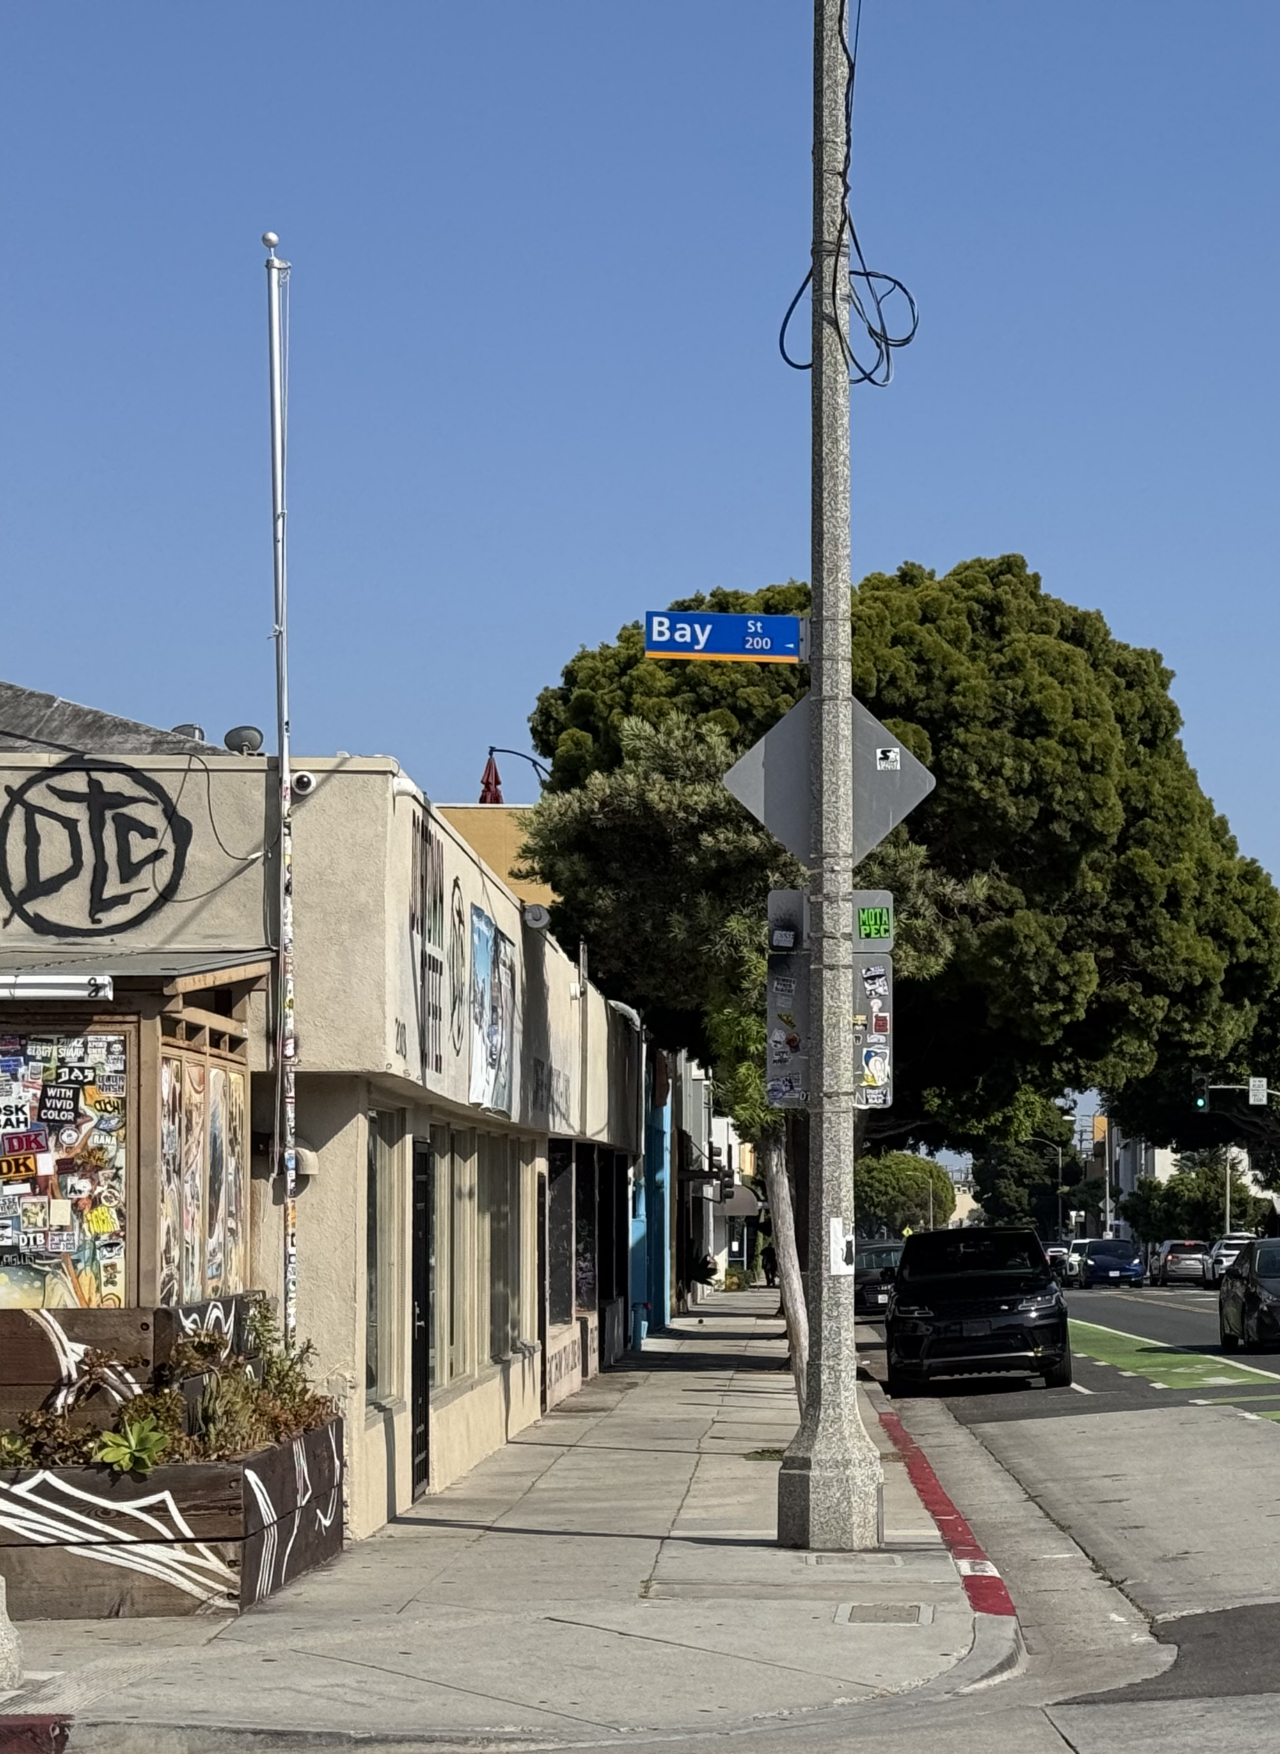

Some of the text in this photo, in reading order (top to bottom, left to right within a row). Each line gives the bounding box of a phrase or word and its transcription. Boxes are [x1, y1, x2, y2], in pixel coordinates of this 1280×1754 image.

[652, 616, 763, 650] Bay St
[744, 637, 771, 650] 200
[859, 908, 889, 926] MOTA
[46, 1087, 74, 1099] WITH
[0, 1104, 28, 1116] SK
[45, 1098, 74, 1110] VIVID
[40, 1110, 75, 1121] COLOR
[0, 1117, 29, 1129] AH
[5, 1132, 46, 1154] DK
[19, 1233, 46, 1246] DTB
